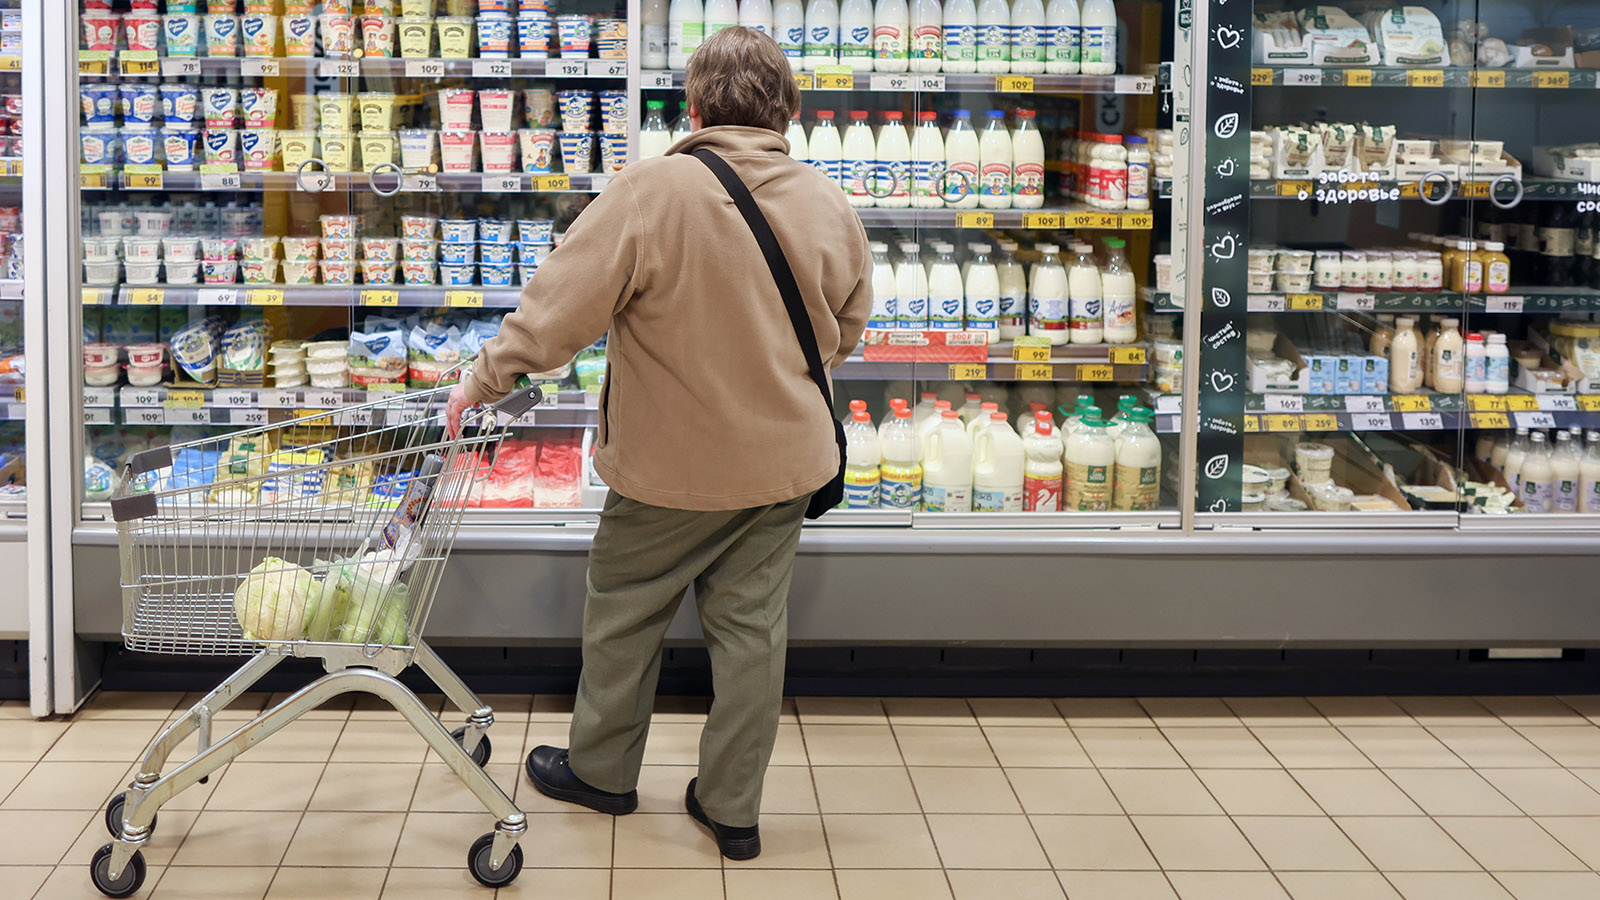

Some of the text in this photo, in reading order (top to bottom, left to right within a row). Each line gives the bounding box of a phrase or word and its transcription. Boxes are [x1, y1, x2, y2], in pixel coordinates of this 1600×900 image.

[183, 63, 194, 72] 78
[261, 64, 273, 73] 99
[421, 65, 438, 73] 109
[490, 65, 505, 74] 122
[562, 66, 578, 74] 139
[608, 66, 620, 74] 67
[655, 77, 666, 86] 81
[836, 78, 847, 86] 99
[1298, 74, 1315, 82] 299
[890, 79, 902, 87] 99
[923, 80, 939, 88] 104
[1012, 81, 1028, 89] 109
[1136, 82, 1147, 90] 87
[1319, 169, 1380, 184] забота
[222, 177, 234, 185] 88
[418, 180, 430, 188] 79
[502, 180, 514, 188] 89
[1297, 188, 1400, 204] о здоровье
[1038, 217, 1053, 225] 109
[1074, 216, 1090, 225] 109
[1101, 217, 1112, 225] 54
[1132, 217, 1148, 226] 109
[217, 294, 230, 302] 69
[466, 296, 478, 304] 74
[1356, 298, 1368, 306] 99
[1267, 300, 1278, 308] 79
[1208, 321, 1233, 343] чистый
[1212, 330, 1237, 349] состав
[965, 368, 981, 377] 219
[135, 396, 152, 404] 109
[228, 396, 244, 404] 109
[1280, 400, 1296, 409] 169
[141, 413, 158, 421] 109
[245, 414, 262, 422] 259
[1368, 419, 1384, 427] 109
